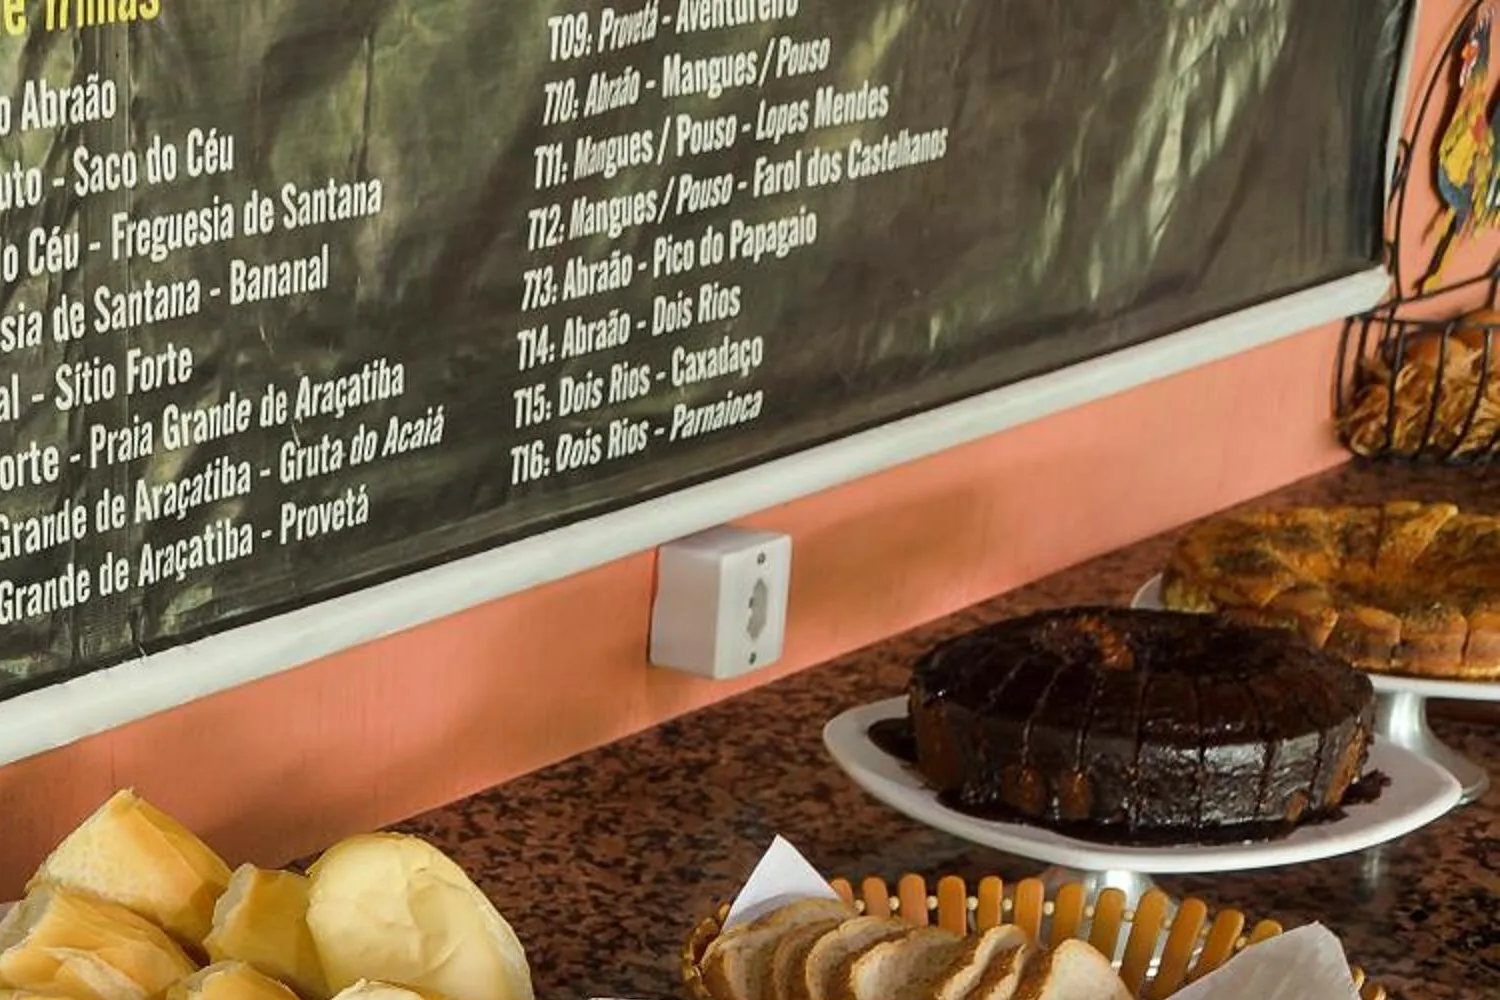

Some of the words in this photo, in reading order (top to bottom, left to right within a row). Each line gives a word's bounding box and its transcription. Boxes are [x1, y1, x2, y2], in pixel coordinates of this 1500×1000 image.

[548, 13, 592, 61] T09:
[598, 0, 658, 52] Provetá
[662, 15, 671, 24] -
[22, 74, 115, 131] Abraão
[544, 78, 578, 124] T10:
[584, 67, 639, 116] Abraão
[645, 80, 656, 89] -
[663, 52, 757, 98] Mangues
[759, 39, 775, 86] /
[777, 37, 830, 77] Pouso
[52, 177, 65, 187] -
[74, 146, 136, 196] Saco
[147, 136, 176, 184] do
[187, 128, 232, 176] Céu
[535, 143, 567, 188] T11:
[574, 130, 653, 179] Mangues
[658, 117, 670, 164] /
[677, 115, 736, 156] Pouso
[742, 123, 751, 132] -
[756, 100, 808, 144] Lopes
[814, 80, 888, 127] Mendes
[29, 226, 78, 275] Céu
[89, 241, 101, 251] -
[113, 196, 233, 261] Freguesia
[244, 190, 273, 235] de
[282, 178, 381, 228] Santana
[529, 204, 564, 250] T12:
[570, 190, 657, 239] Mangues
[658, 177, 674, 223] /
[676, 174, 732, 214] Pouso
[737, 181, 747, 190] -
[754, 150, 801, 196] Farol
[807, 147, 842, 186] dos
[848, 128, 948, 179] Castelhanos
[54, 295, 84, 342] de
[95, 280, 200, 332] Santana
[209, 287, 221, 297] -
[231, 244, 328, 304] Bananal
[522, 266, 557, 310] T13:
[563, 250, 632, 300] Abraão
[637, 262, 647, 271] -
[654, 235, 694, 277] Pico
[700, 226, 723, 266] do
[730, 206, 816, 262] Papagaio
[518, 325, 554, 370] T14:
[562, 310, 630, 358] Abraão
[637, 320, 646, 329] -
[653, 291, 692, 335] Dois
[698, 283, 740, 322] Rios
[31, 393, 45, 402] -
[56, 357, 115, 410] Sítio
[128, 343, 192, 394] Forte
[69, 453, 81, 463] -
[91, 416, 152, 468] Praia
[163, 392, 251, 450] Grande
[260, 384, 286, 426] de
[295, 359, 403, 422] Araçatiba
[514, 384, 551, 428] T15:
[560, 372, 603, 416] Dois
[609, 362, 650, 402] Rios
[656, 371, 666, 380] -
[673, 336, 762, 386] Caxadaço
[96, 489, 125, 532] de
[135, 456, 250, 528] Araçatiba
[259, 468, 271, 477] -
[281, 435, 343, 483] Gruta
[350, 424, 377, 464] do
[382, 406, 444, 456] Acaiá
[511, 440, 549, 484] T16:
[557, 429, 601, 471] Dois
[608, 418, 648, 458] Rios
[654, 427, 665, 435] -
[670, 391, 762, 440] Parnaioca
[100, 552, 128, 595] de
[137, 518, 254, 590] Araçatiba
[261, 529, 272, 539] -
[281, 485, 368, 544] Provetá
